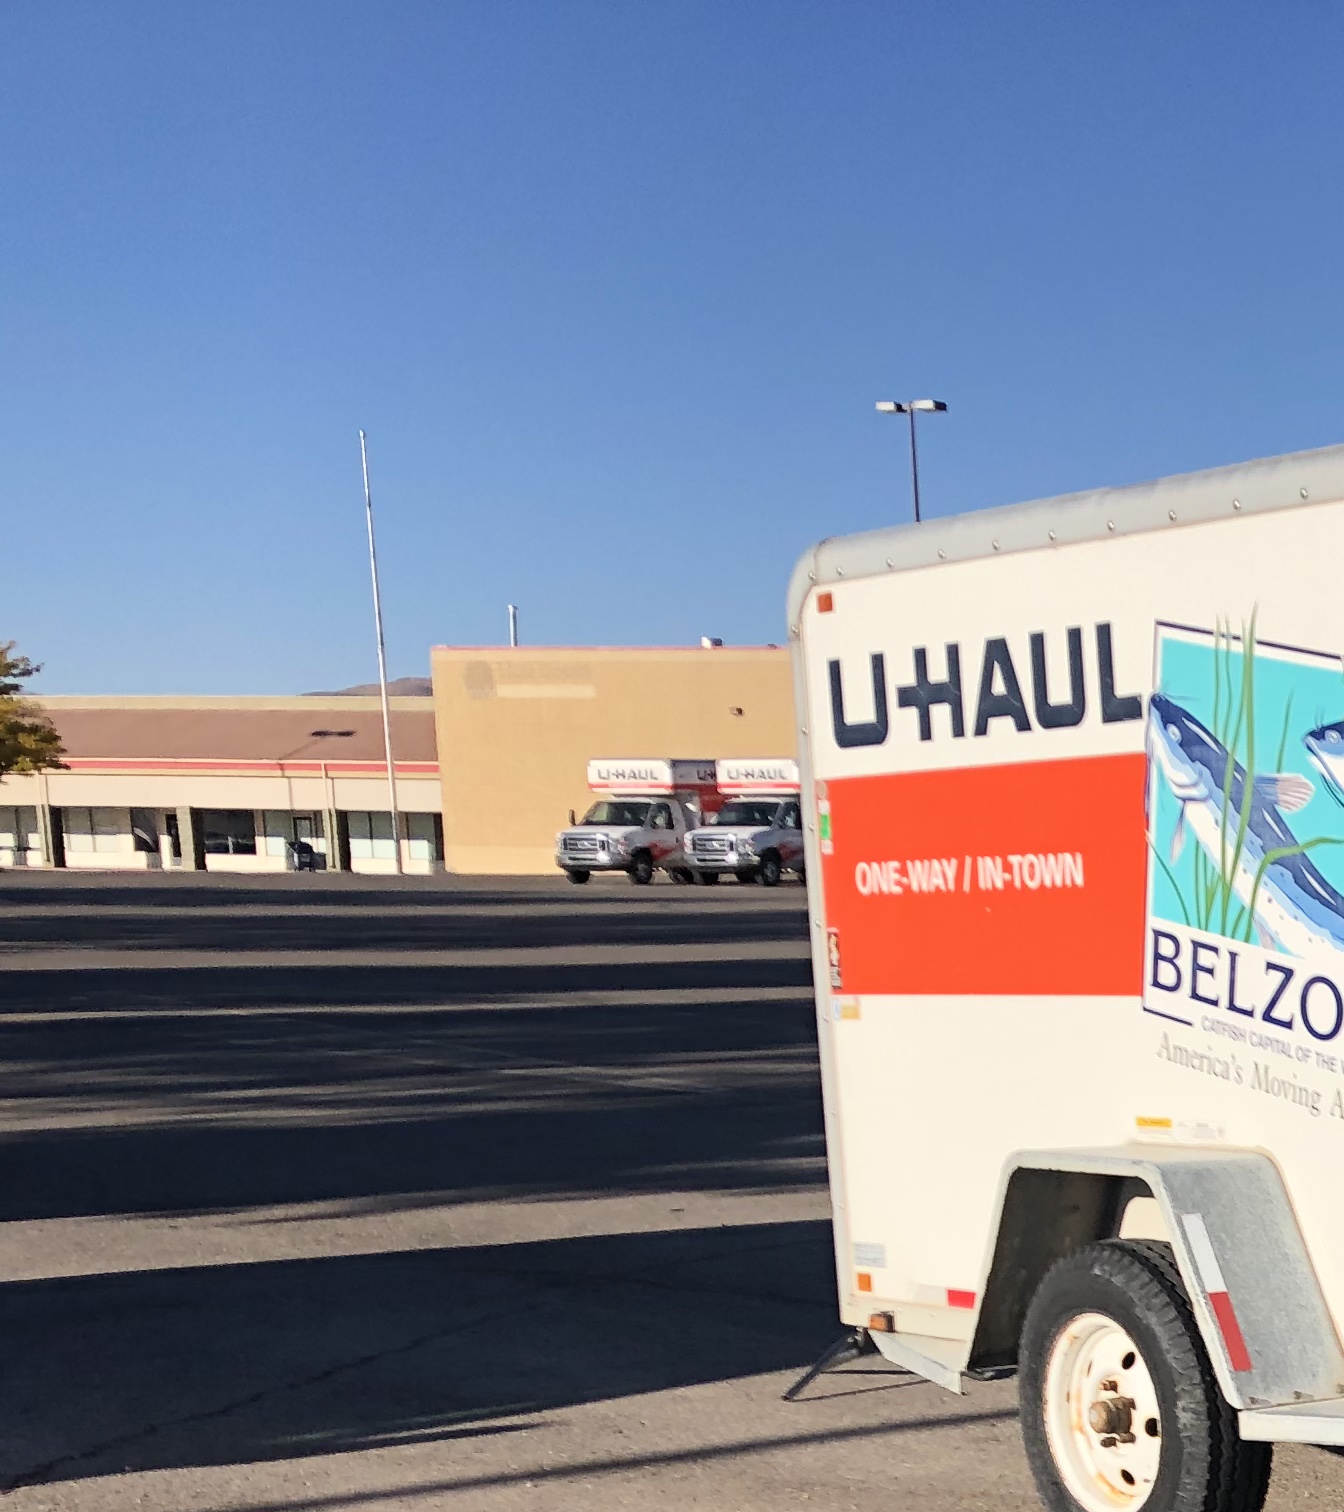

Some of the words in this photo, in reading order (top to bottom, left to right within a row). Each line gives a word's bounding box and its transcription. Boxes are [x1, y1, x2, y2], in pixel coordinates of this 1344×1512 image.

[828, 622, 1143, 750] U-HAUL
[855, 857, 958, 895] ONE-WAY
[977, 852, 1084, 890] IN-TOWN
[1156, 1031, 1244, 1086] America's
[1250, 1061, 1323, 1117] Moving
[1200, 1015, 1248, 1045] CATFISH
[1249, 1027, 1294, 1060] CAPITAL
[1295, 1046, 1313, 1063] OF
[1314, 1051, 1337, 1075] THE
